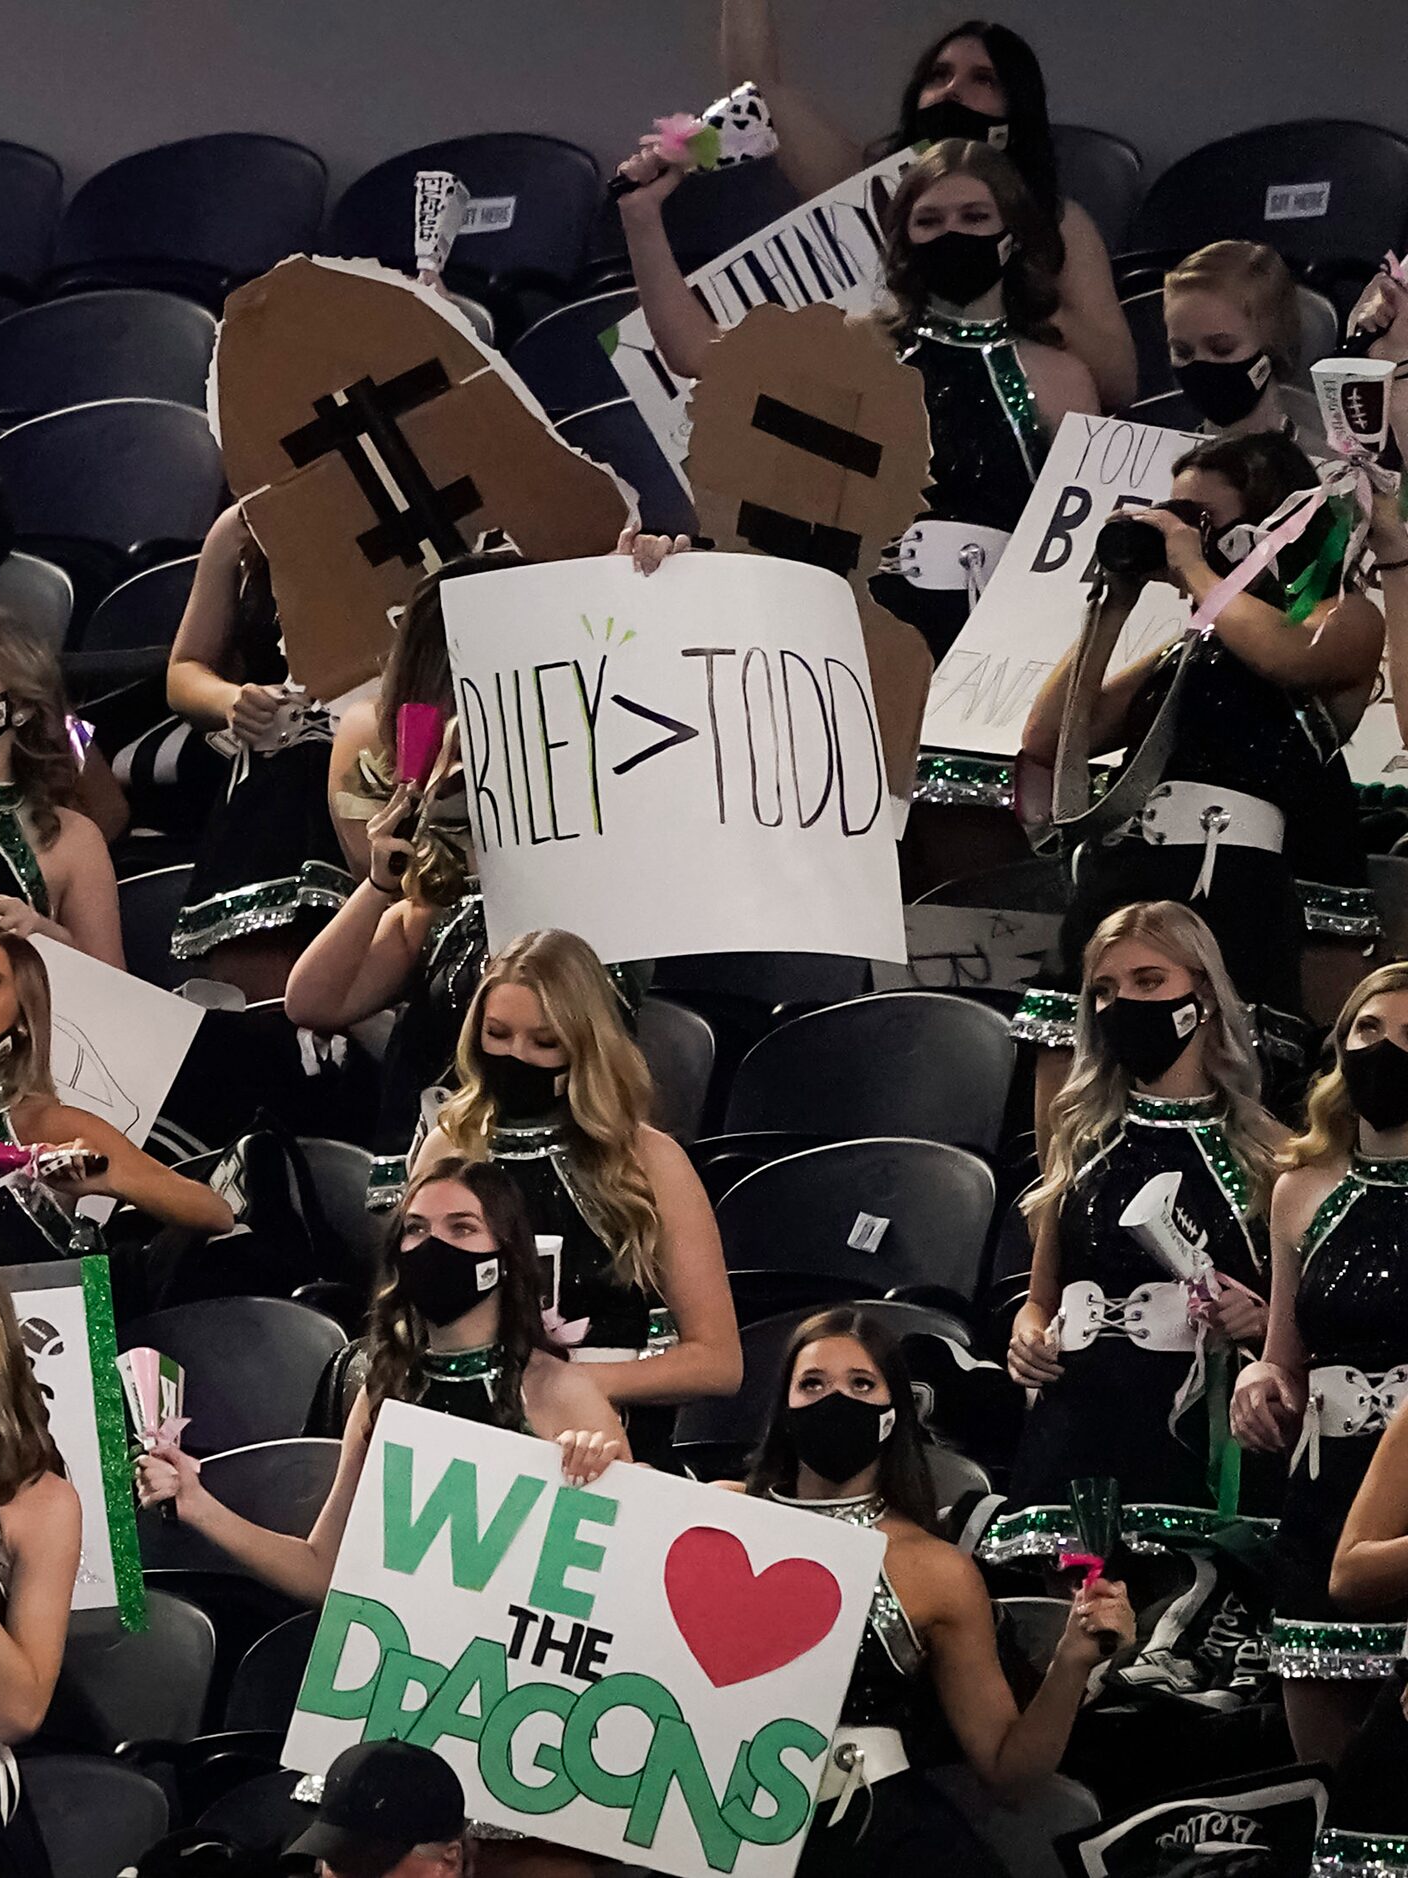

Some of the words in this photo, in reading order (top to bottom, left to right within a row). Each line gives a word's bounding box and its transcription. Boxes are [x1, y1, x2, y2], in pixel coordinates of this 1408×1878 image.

[1073, 416, 1163, 489] YOU
[460, 654, 608, 853] RILEY
[681, 646, 882, 838] TODD
[383, 1440, 619, 1621] WE
[295, 1588, 829, 1874] DRAGONS
[507, 1604, 614, 1684] THE
